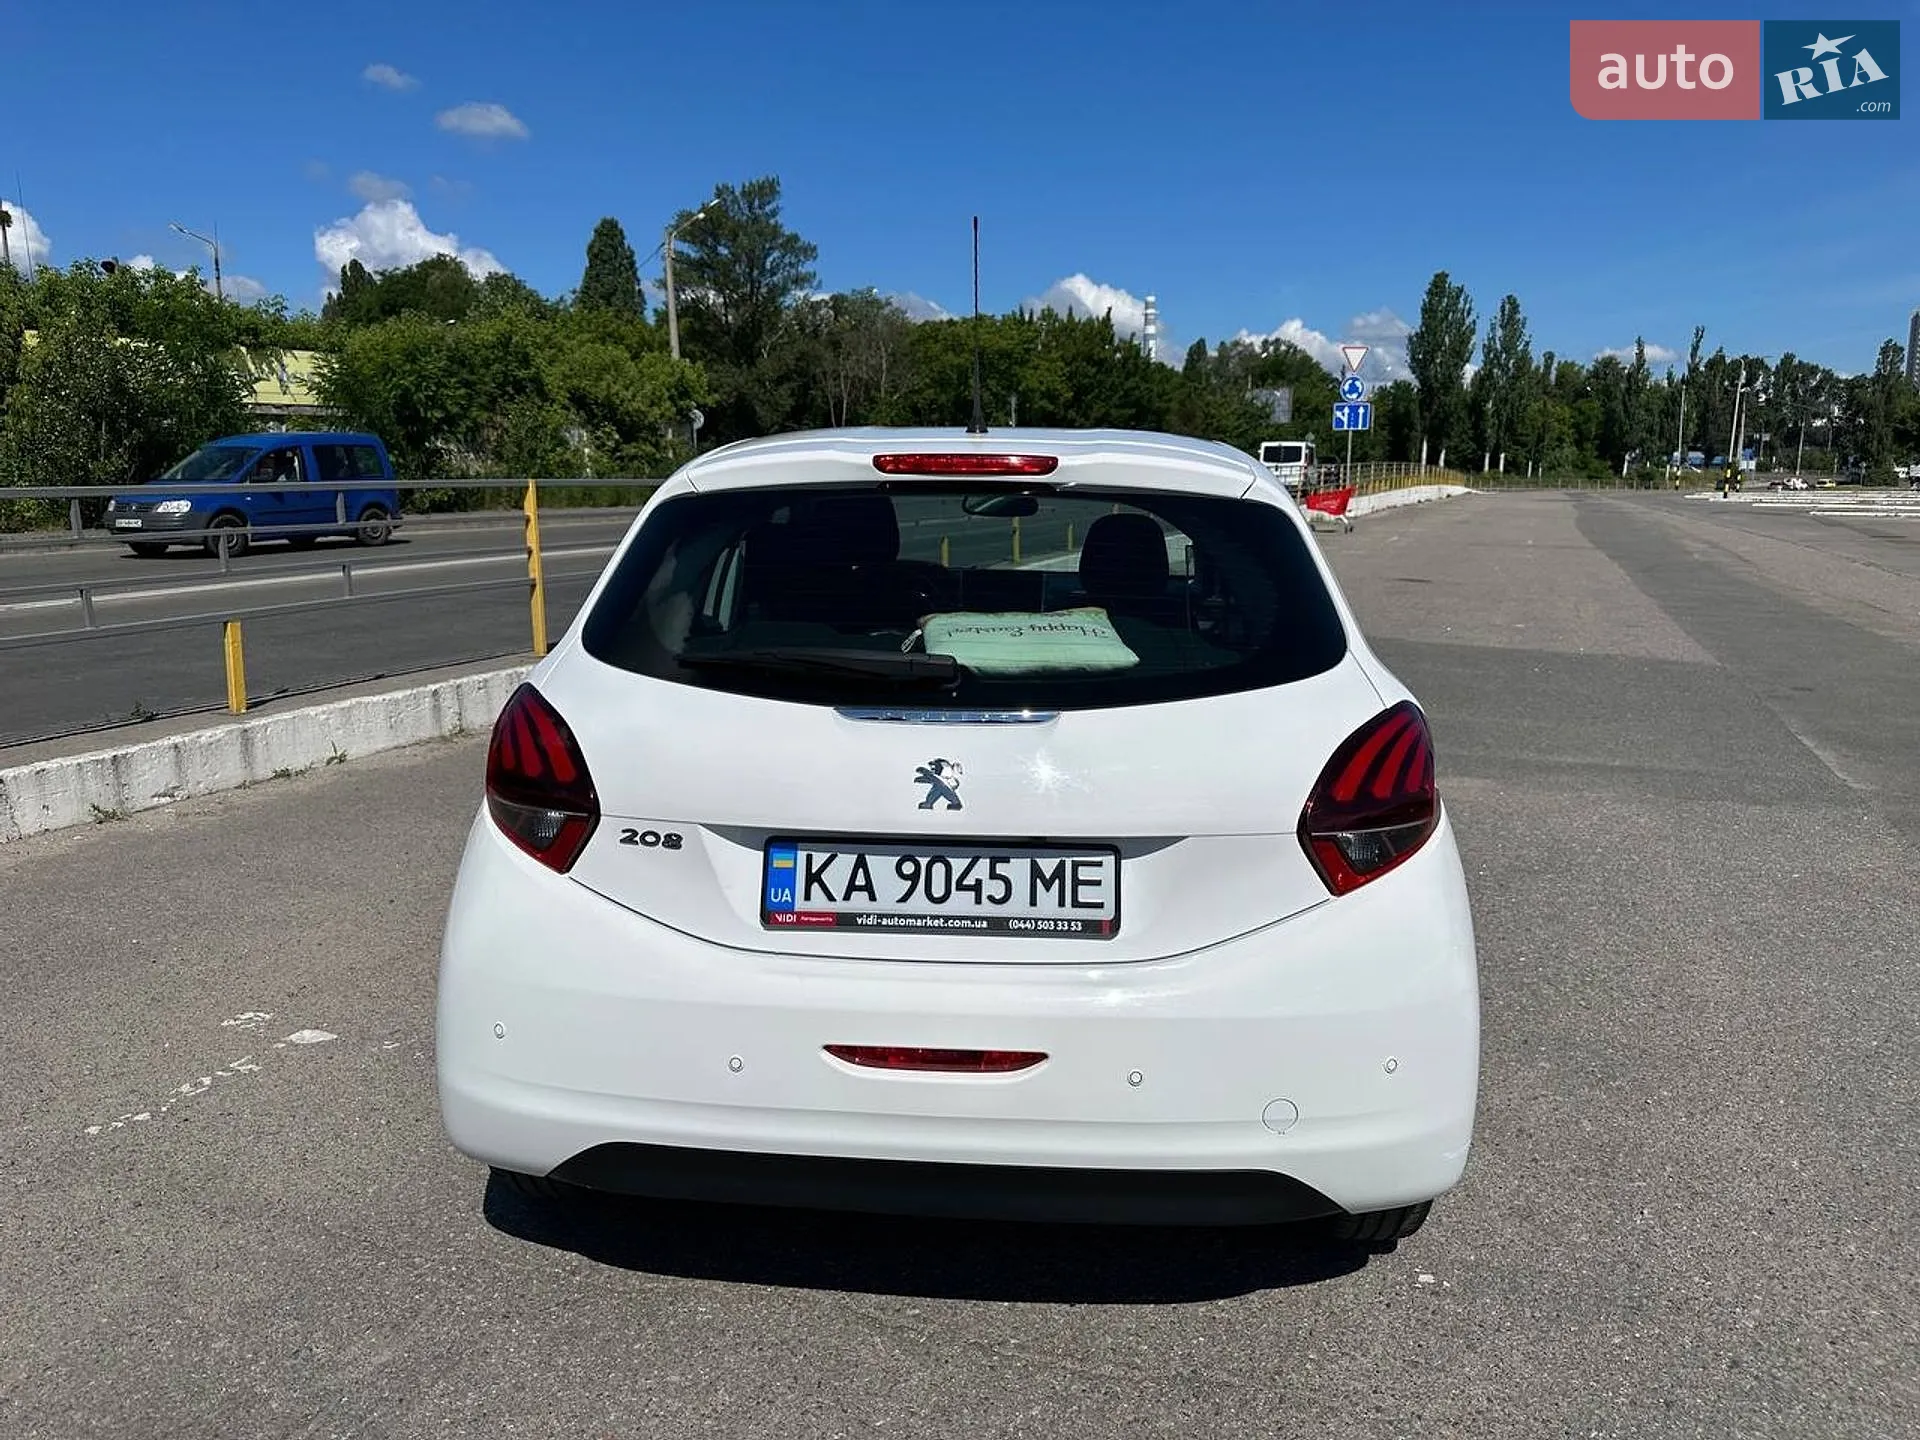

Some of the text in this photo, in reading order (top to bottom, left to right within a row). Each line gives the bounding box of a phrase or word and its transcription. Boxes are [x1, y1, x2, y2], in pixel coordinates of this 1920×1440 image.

[619, 828, 683, 850] 208
[804, 852, 1105, 909] KA 9045 ME
[770, 888, 792, 903] UA
[775, 913, 797, 923] VIDI
[856, 915, 988, 929] vidi-automarket.com.ua
[1008, 919, 1083, 931] (044) 503 33 53
